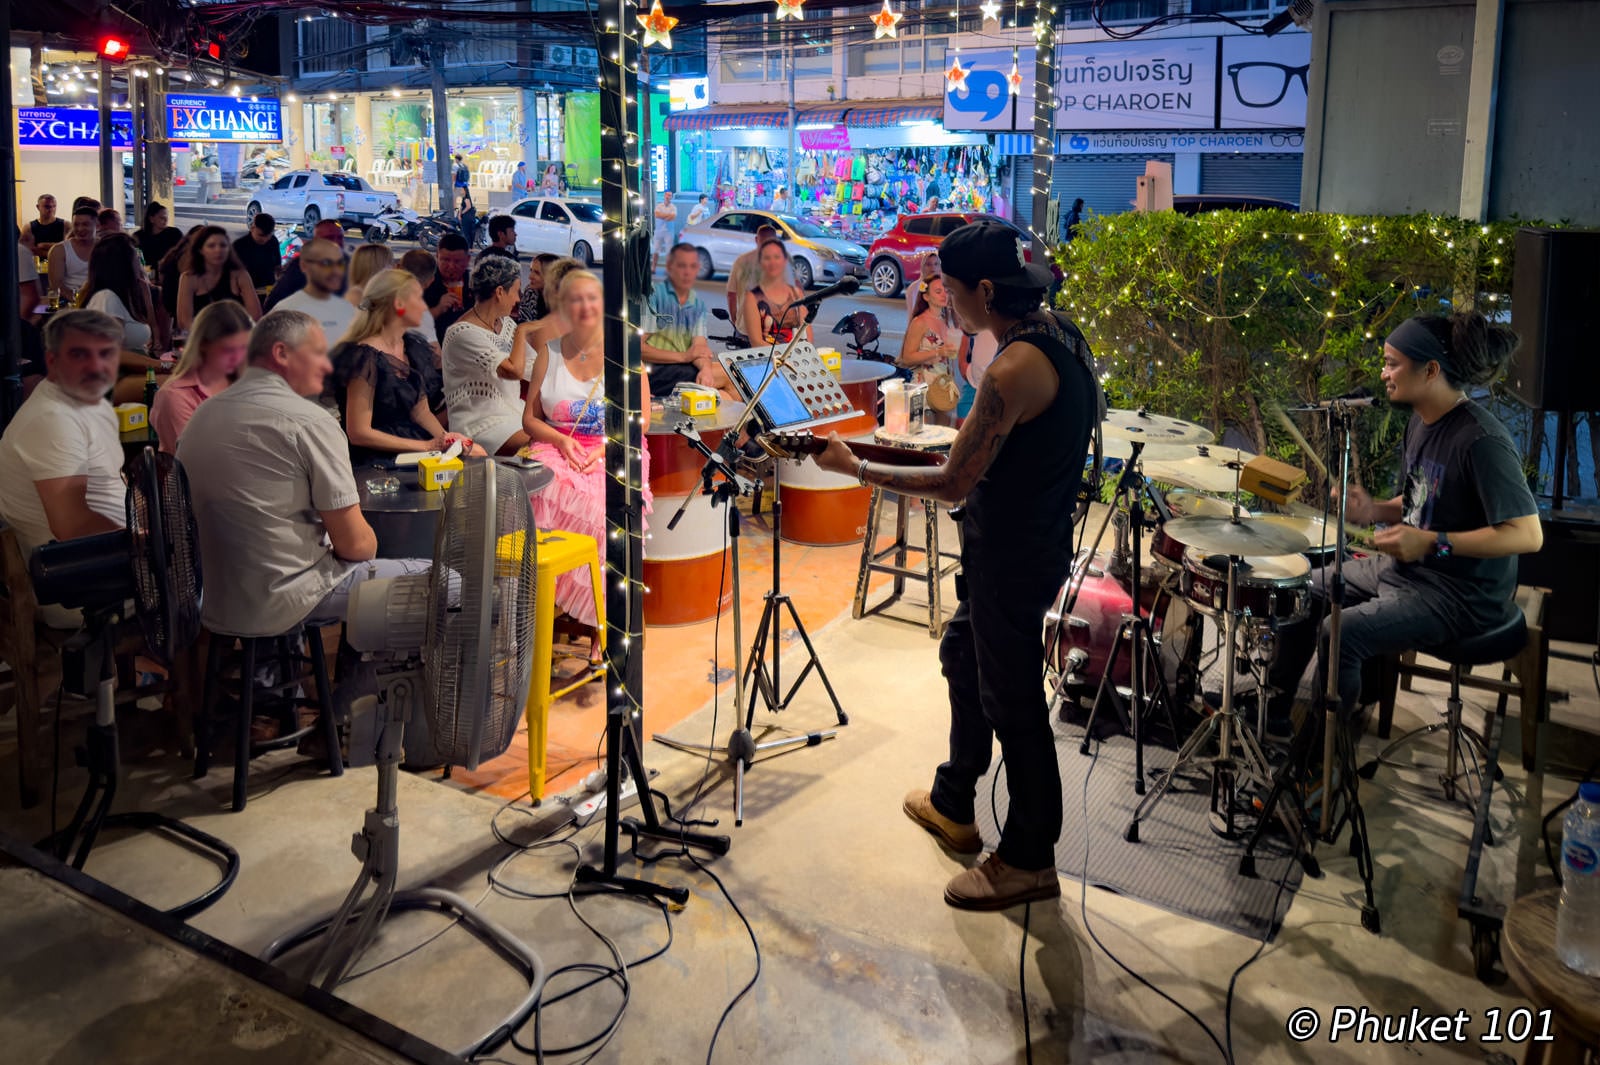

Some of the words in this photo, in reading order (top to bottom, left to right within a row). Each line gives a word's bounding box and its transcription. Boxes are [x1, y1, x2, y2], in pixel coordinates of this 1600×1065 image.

[1053, 57, 1193, 85] ว่นท็อปเจริญ
[170, 98, 206, 106] CURRENCY
[1083, 92, 1192, 111] CHAROEN
[19, 111, 57, 120] urrency
[172, 108, 278, 131] EXCHANGE
[1171, 136, 1196, 146] TOP
[1200, 136, 1264, 147] CHAROEN
